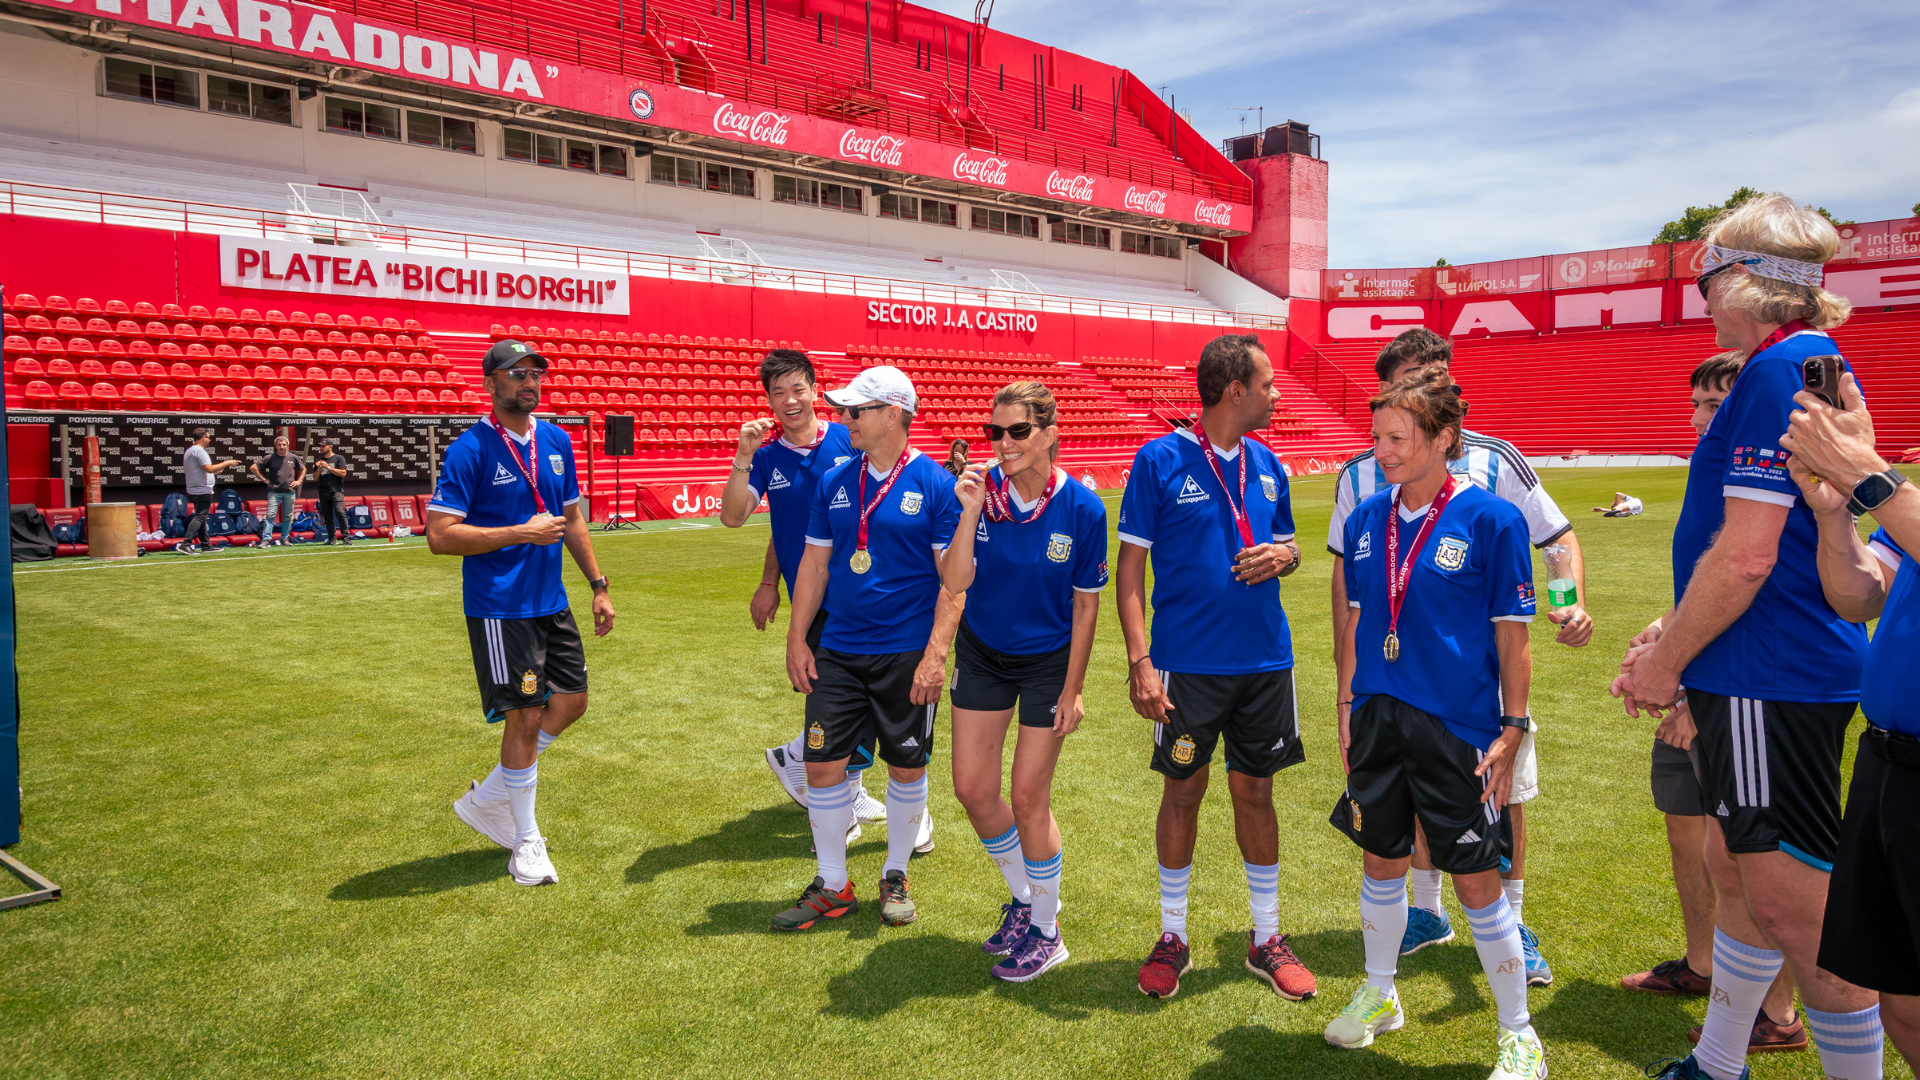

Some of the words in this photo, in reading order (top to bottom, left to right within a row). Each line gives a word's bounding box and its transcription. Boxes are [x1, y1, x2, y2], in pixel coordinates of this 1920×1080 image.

[1868, 244, 1920, 257] assista
[237, 248, 378, 287] PLATEA
[1592, 258, 1656, 274] Morita
[1363, 278, 1414, 288] intermac
[1458, 280, 1498, 292] LIMPOL
[1500, 279, 1517, 288] S.A.
[1363, 288, 1415, 298] assistance
[868, 301, 936, 326] SECTOR
[976, 311, 1038, 332] CASTRO
[373, 509, 387, 521] 10
[399, 508, 413, 520] 10
